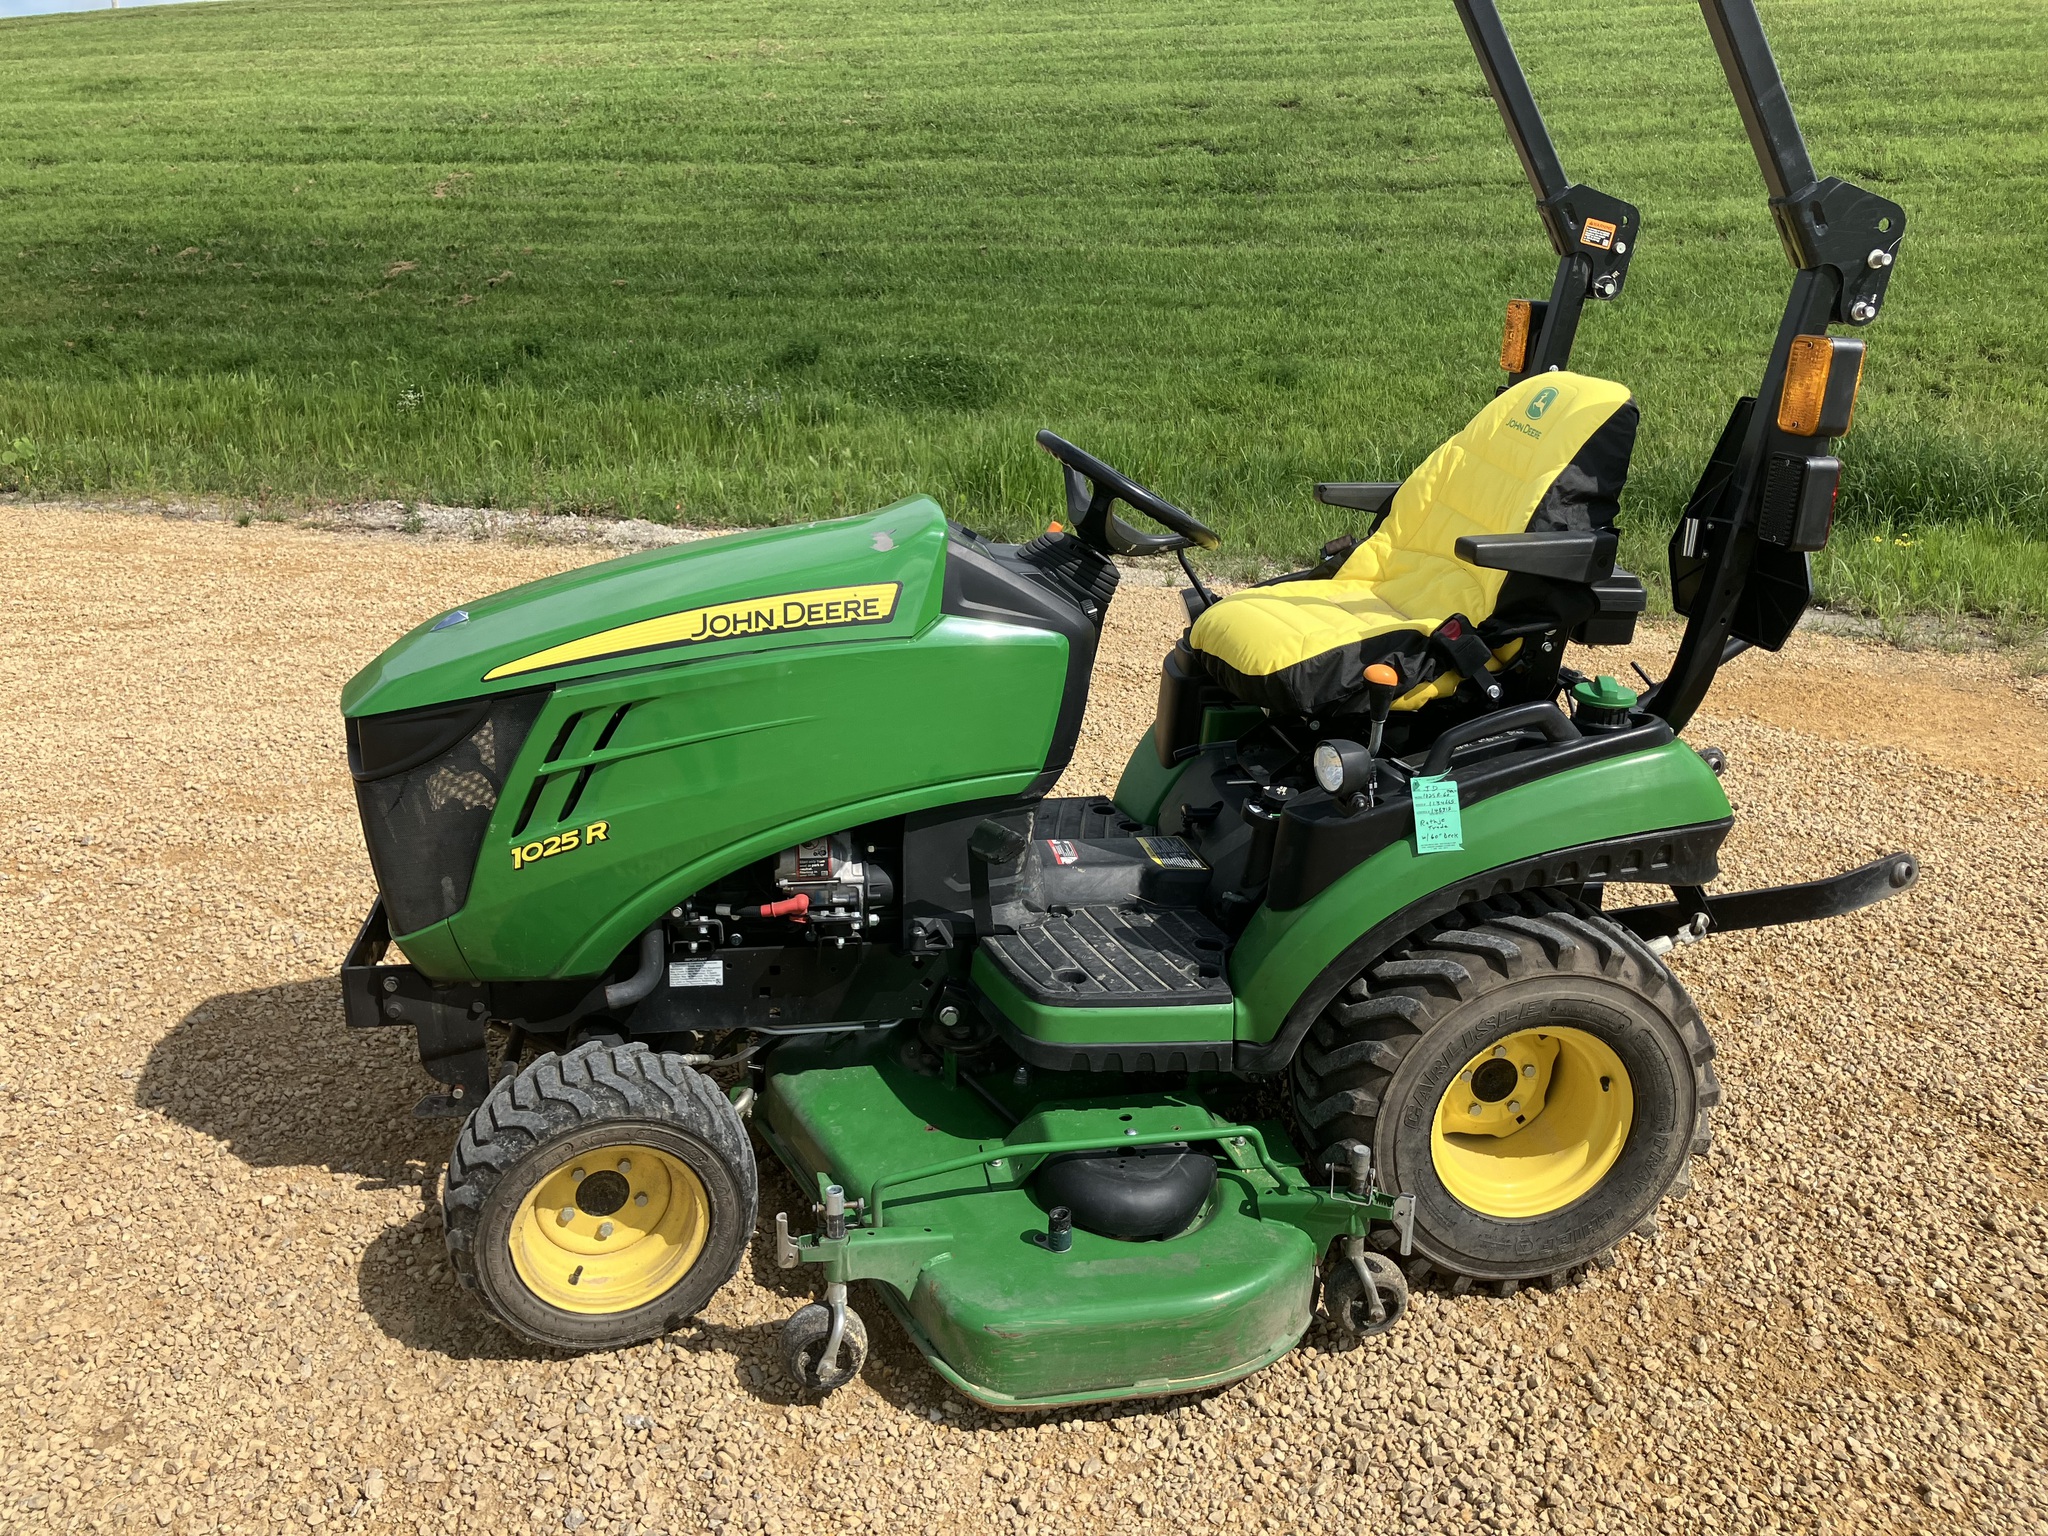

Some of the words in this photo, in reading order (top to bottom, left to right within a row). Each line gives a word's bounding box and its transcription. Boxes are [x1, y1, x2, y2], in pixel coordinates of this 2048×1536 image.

[1506, 418, 1524, 433] JOHN
[1523, 424, 1542, 440] DEERE
[691, 608, 774, 638] JOHN
[782, 597, 880, 628] DEERE
[511, 829, 581, 871] 1025
[586, 821, 610, 845] R
[1403, 999, 1546, 1130] CARLISLE
[1625, 1135, 1670, 1203] TRAC
[1538, 1207, 1615, 1254] CHIEF
